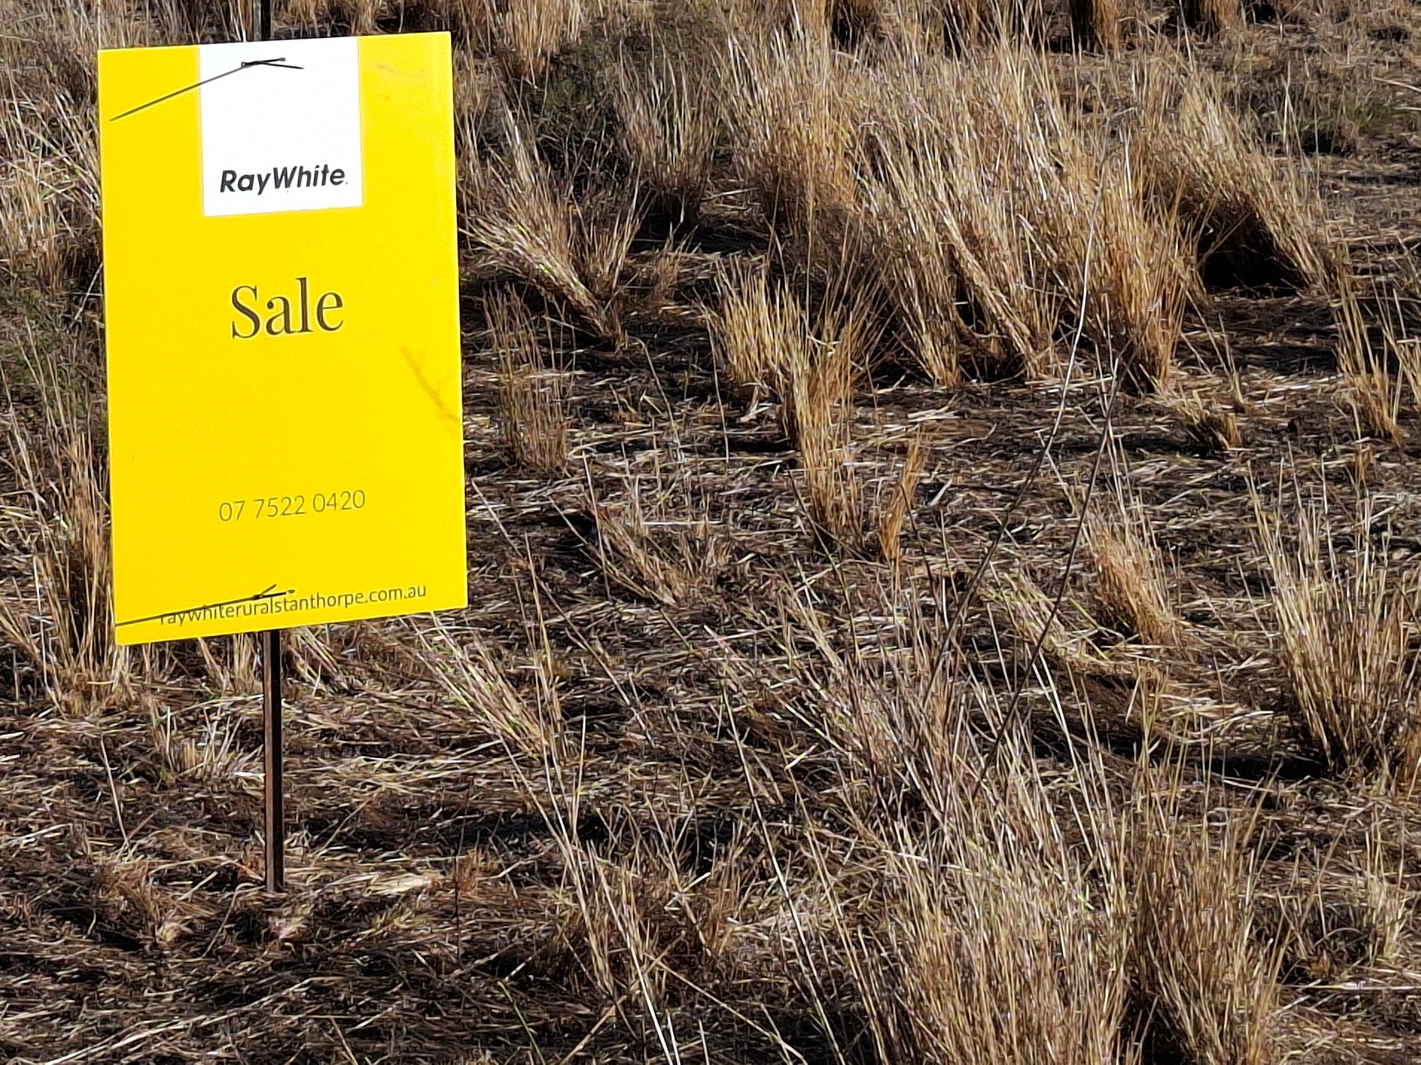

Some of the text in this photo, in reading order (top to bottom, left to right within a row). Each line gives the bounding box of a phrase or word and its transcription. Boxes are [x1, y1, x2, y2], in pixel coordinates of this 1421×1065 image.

[231, 277, 344, 339] Sale
[219, 489, 366, 522] 07 7522 0420
[160, 585, 427, 627] raywhiteruralstanthorpe.com.au
